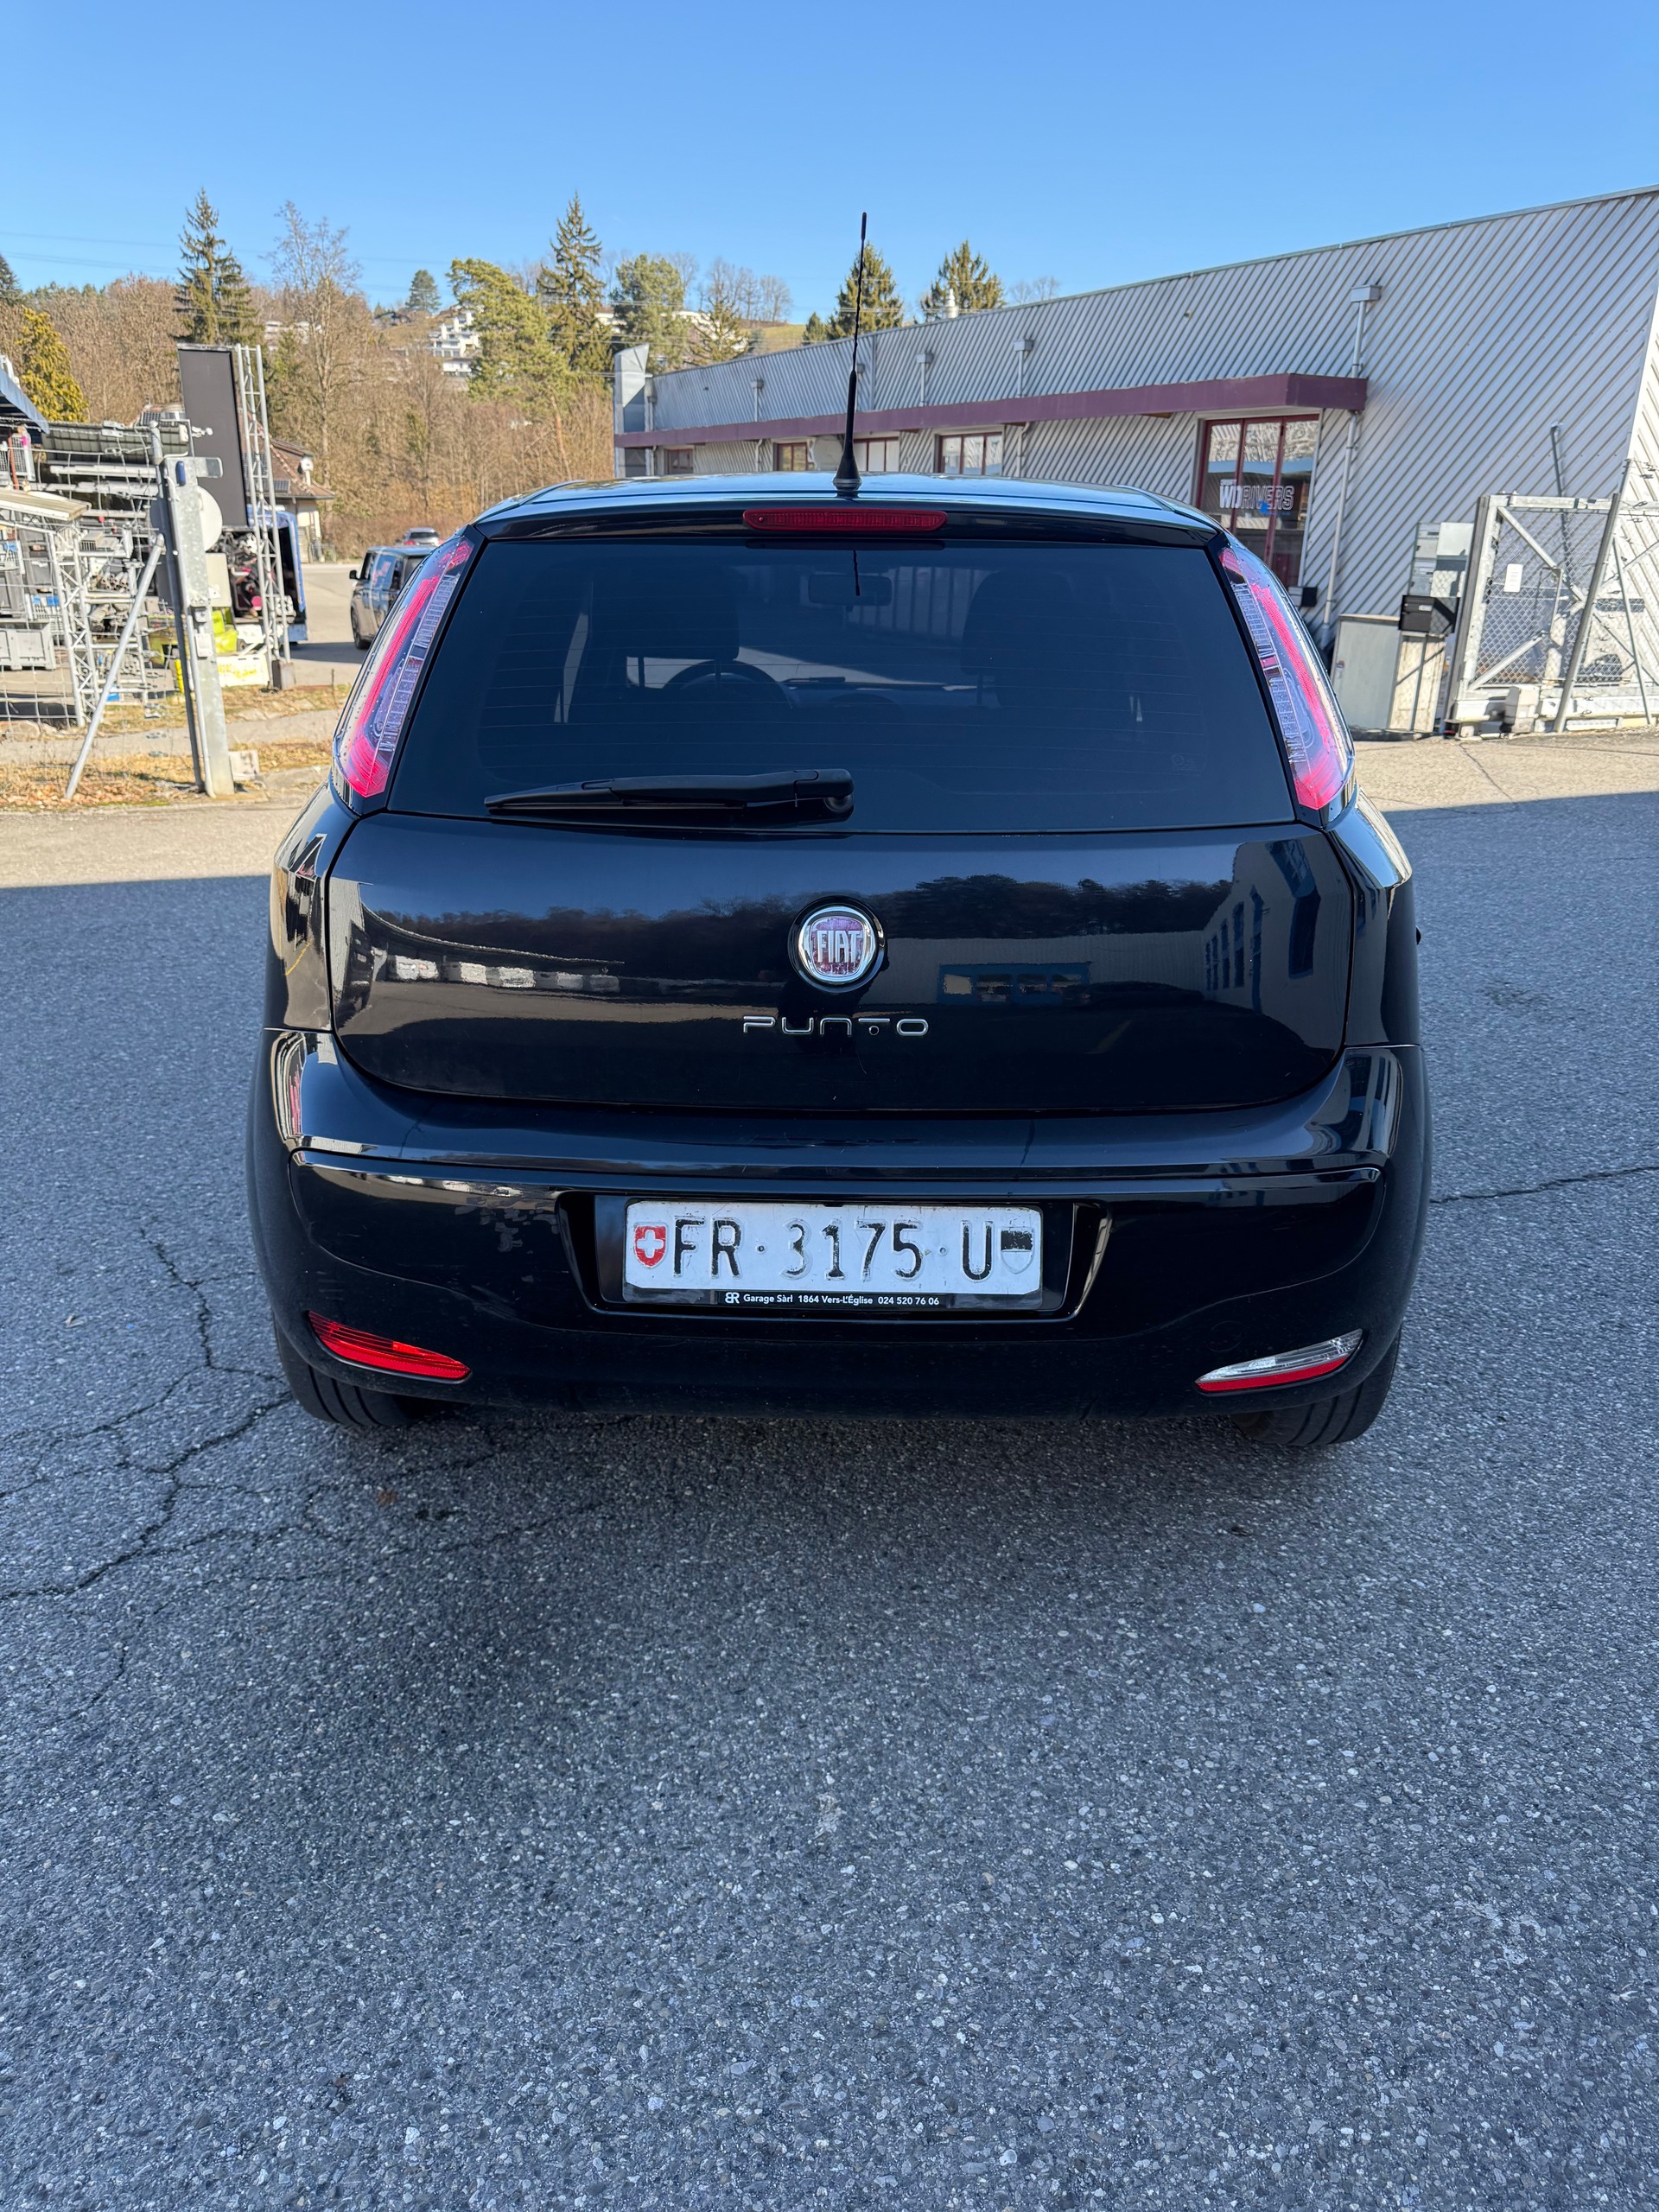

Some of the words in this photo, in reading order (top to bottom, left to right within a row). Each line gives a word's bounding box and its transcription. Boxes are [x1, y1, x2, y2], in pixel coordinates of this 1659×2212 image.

[817, 930, 861, 963] FIAT
[743, 1015, 929, 1036] PUNTO
[673, 1217, 741, 1277] FR
[780, 1218, 923, 1281] 3175
[960, 1221, 994, 1281] U
[743, 1294, 774, 1304] Garage
[777, 1294, 793, 1303] Sàrl
[878, 1296, 894, 1305] 024
[897, 1296, 912, 1305] 520
[928, 1297, 939, 1306] 06
